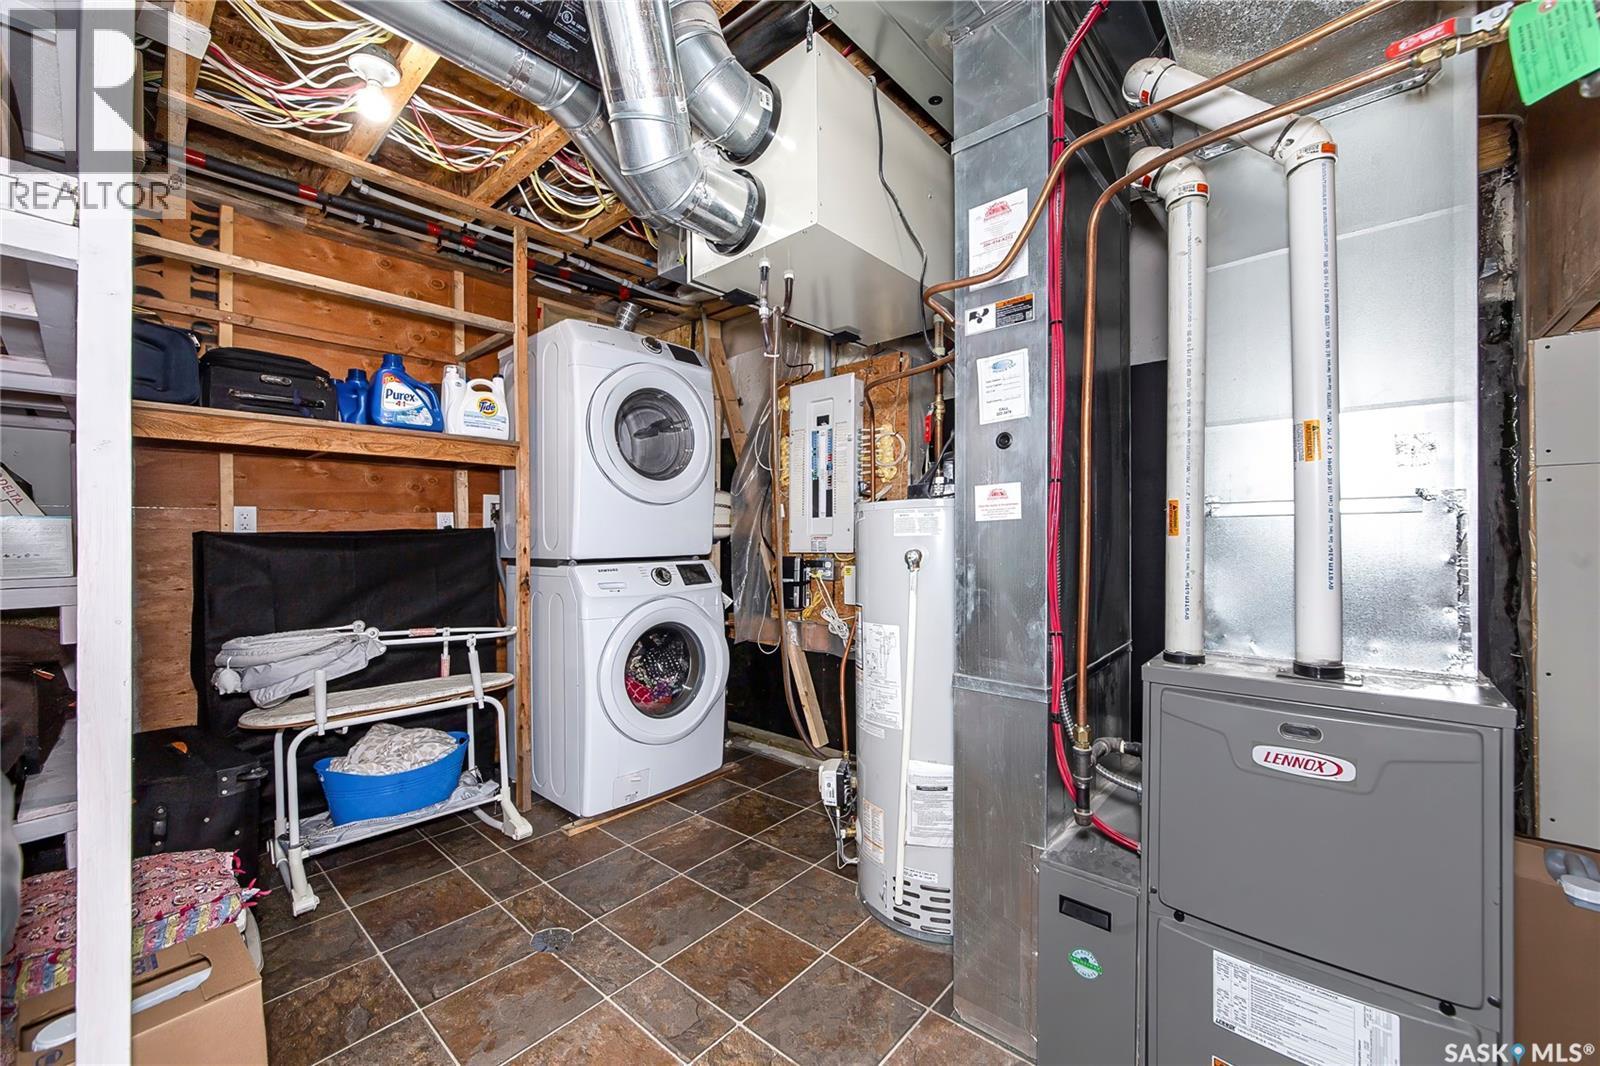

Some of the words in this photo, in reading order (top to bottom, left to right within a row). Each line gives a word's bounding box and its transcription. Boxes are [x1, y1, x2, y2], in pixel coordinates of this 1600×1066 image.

[385, 388, 416, 402] Purex
[479, 401, 496, 412] Tide
[1263, 751, 1327, 773] LENNOX
